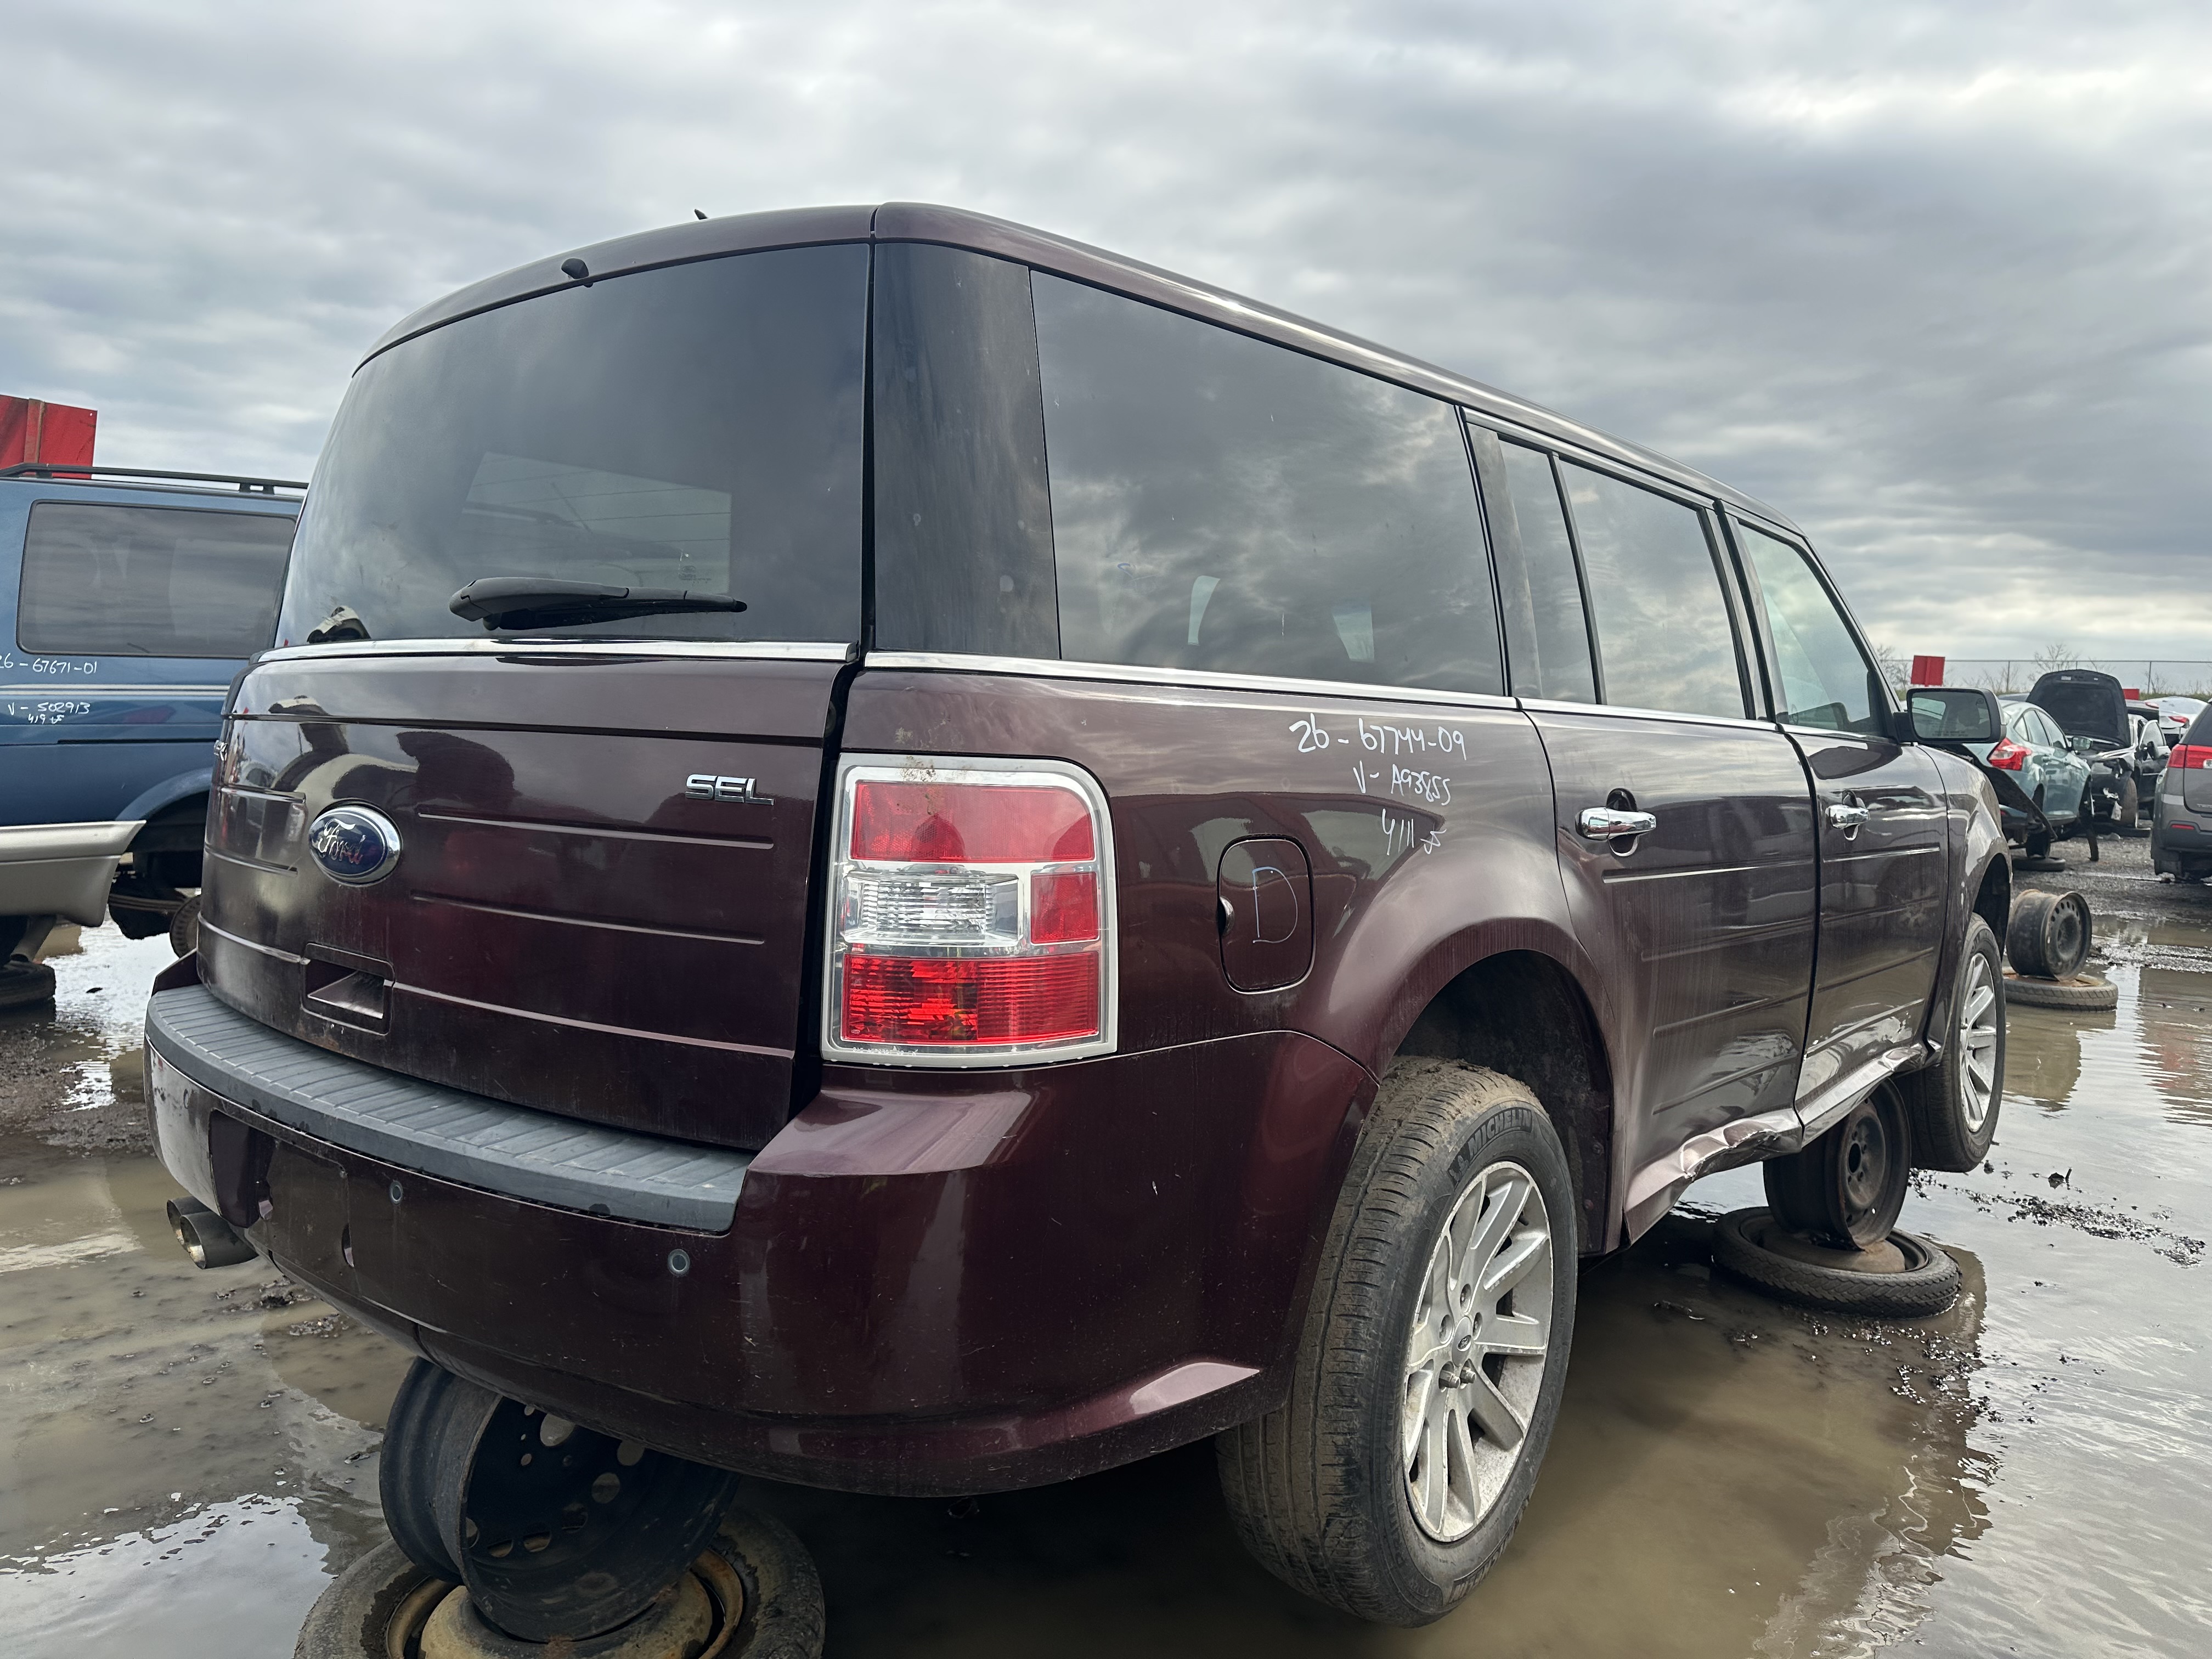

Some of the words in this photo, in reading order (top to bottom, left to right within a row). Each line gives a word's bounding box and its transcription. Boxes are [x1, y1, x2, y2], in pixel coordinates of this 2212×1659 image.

[686, 774, 775, 806] SEL
[318, 818, 366, 865] Ford
[1252, 866, 1298, 944] D
[1467, 1107, 1532, 1156] MICHELIN
